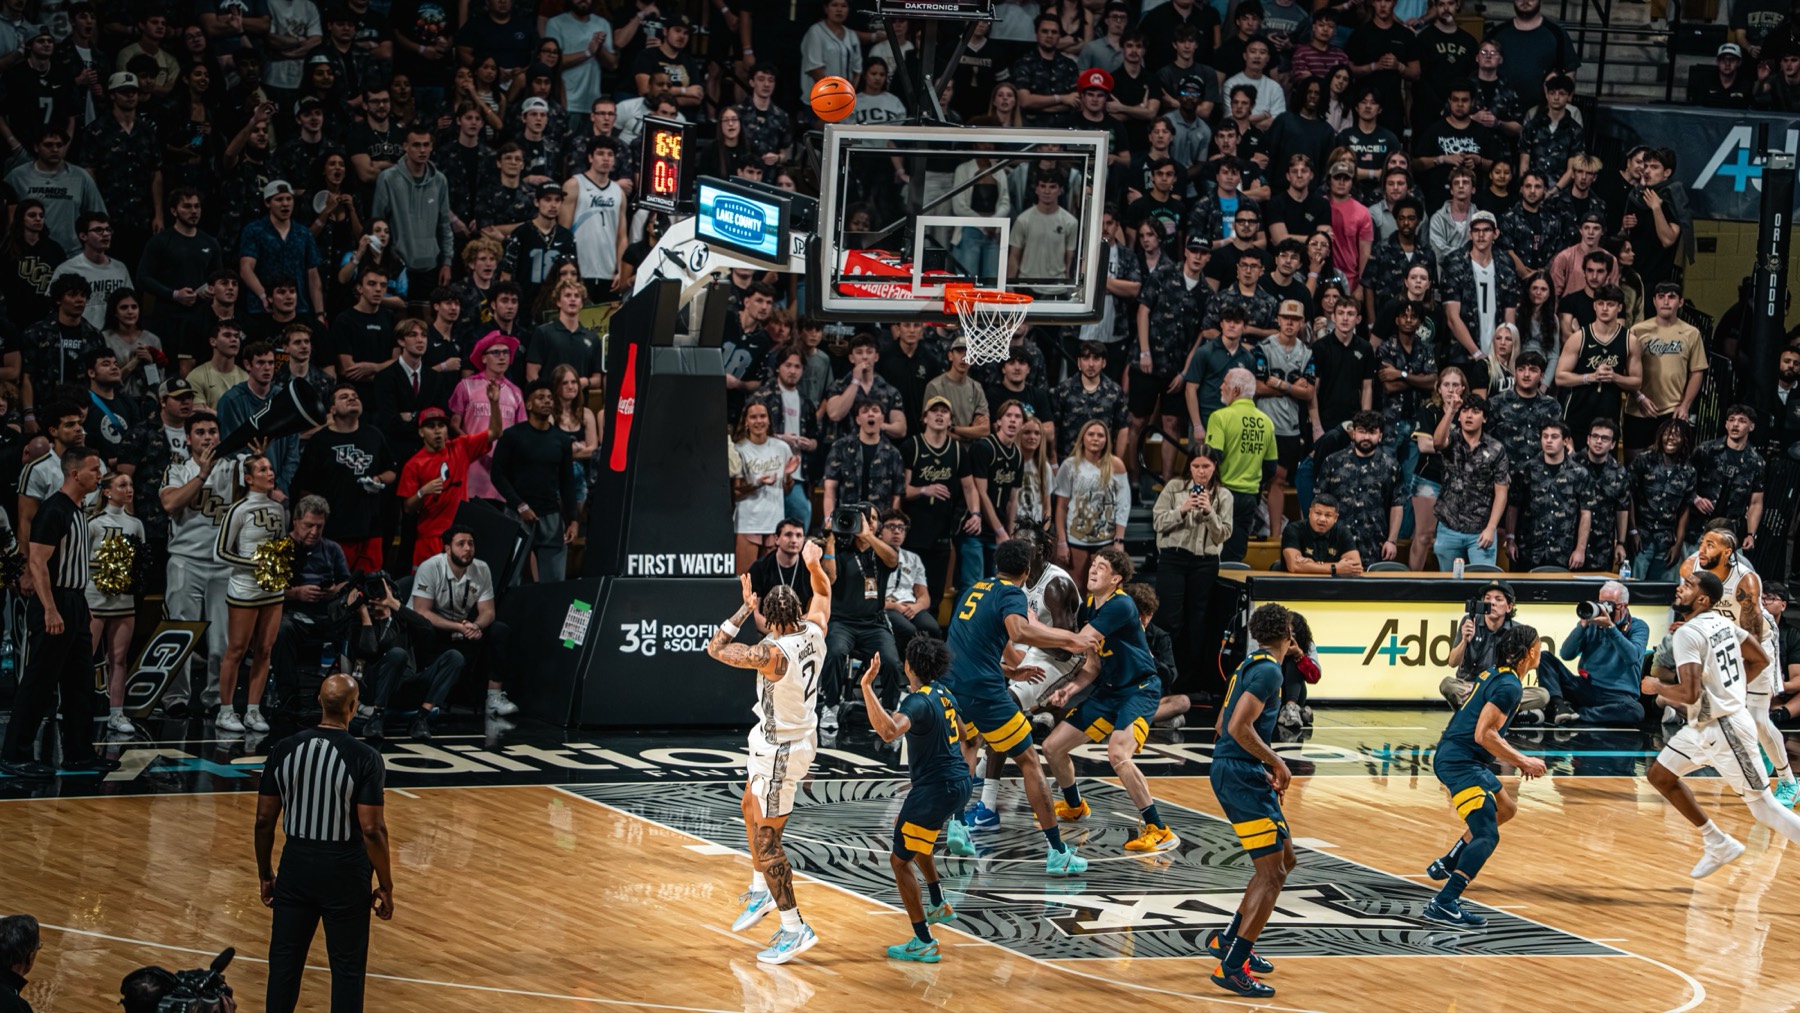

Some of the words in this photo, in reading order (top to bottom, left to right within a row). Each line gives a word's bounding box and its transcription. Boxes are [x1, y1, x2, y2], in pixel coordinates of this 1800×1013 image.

[904, 2, 959, 11] DAKTRONICS
[1435, 42, 1467, 56] UCF
[39, 97, 54, 124] 7
[856, 108, 897, 124] UCF
[599, 211, 606, 227] 1
[715, 207, 735, 222] LAKE
[734, 214, 762, 232] COUNTY
[18, 255, 53, 295] UCF
[1479, 282, 1488, 314] 1
[1643, 340, 1684, 357] Knights
[1241, 416, 1264, 429] CSC
[1241, 429, 1264, 442] EVENT
[1240, 441, 1264, 455] STAFF
[331, 444, 373, 475] UCF
[919, 465, 952, 482] Knights
[996, 486, 1003, 509] 1
[627, 554, 676, 575] FIRST
[680, 553, 735, 574] WATCH
[958, 592, 984, 621] 5
[1715, 643, 1740, 688] 35
[802, 659, 817, 703] 2
[944, 708, 960, 744] 3
